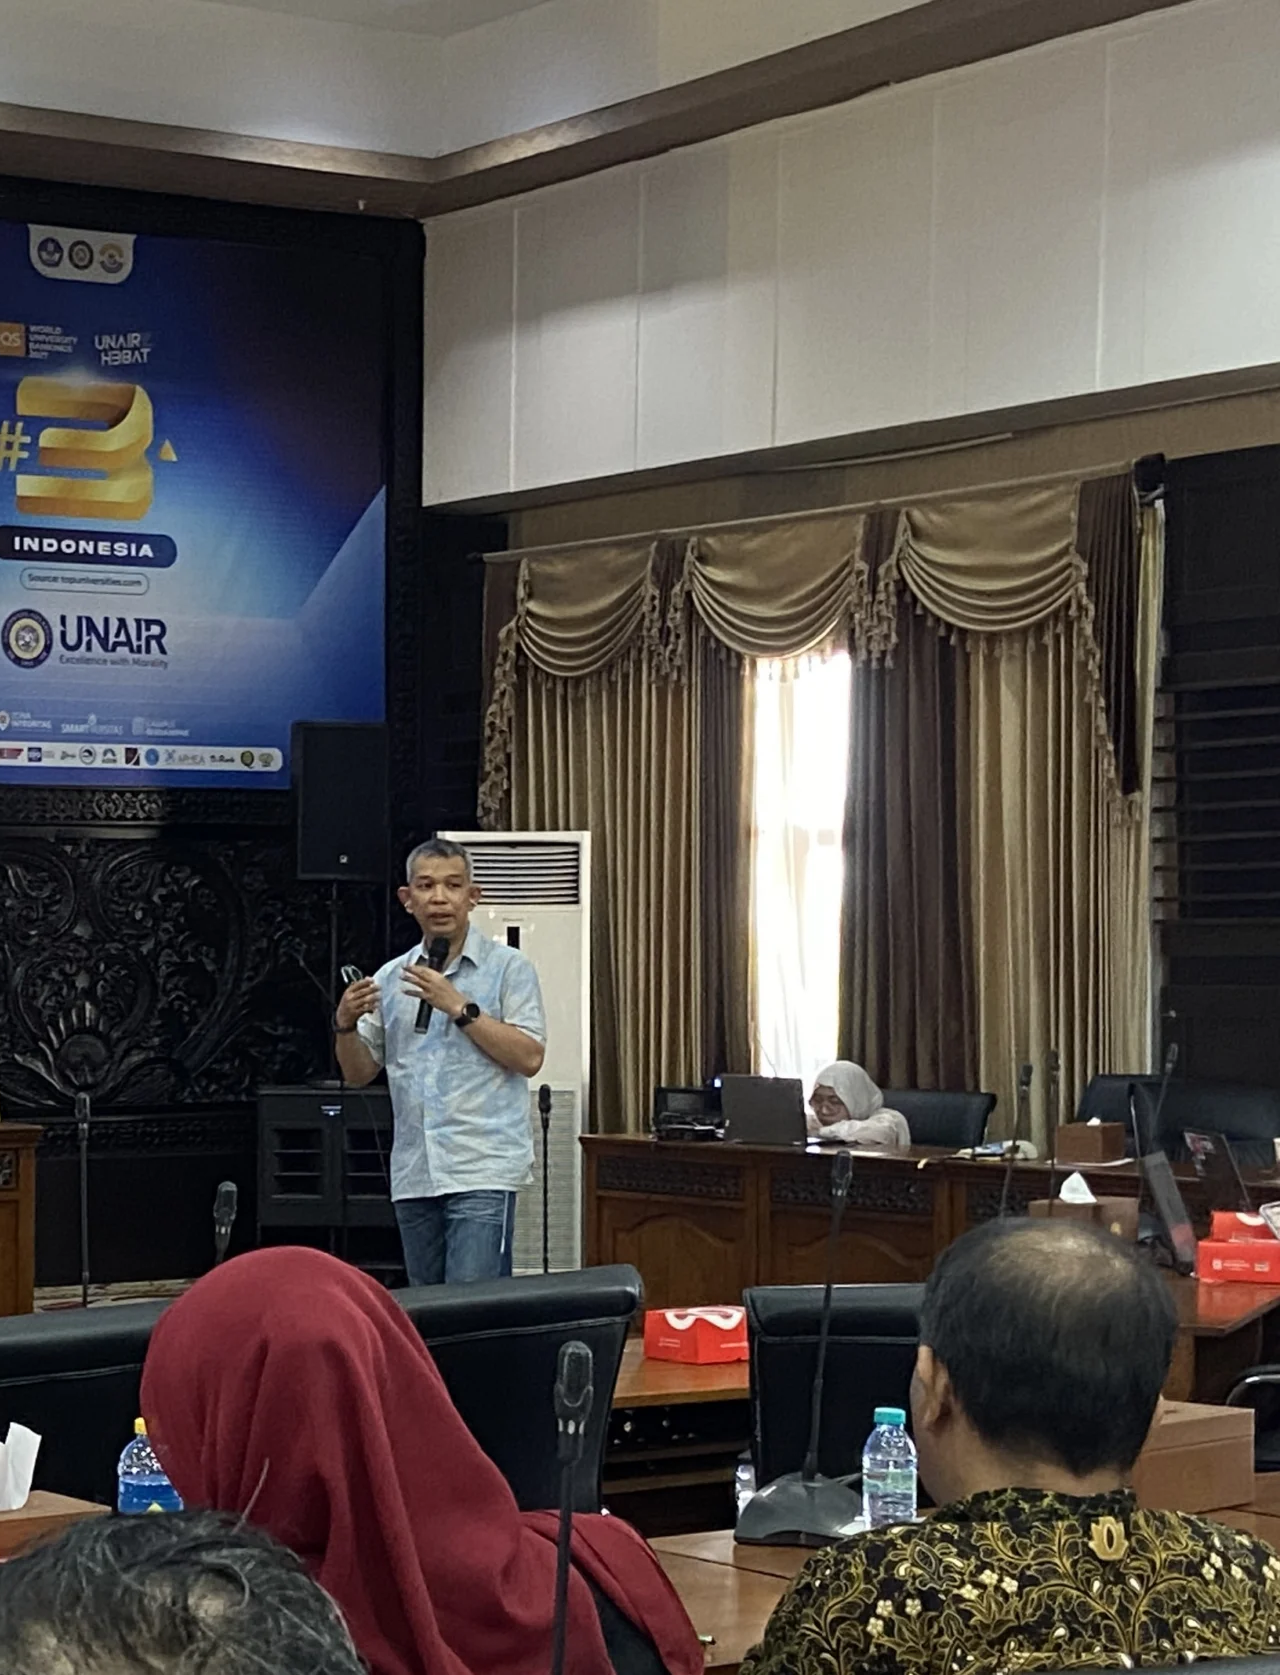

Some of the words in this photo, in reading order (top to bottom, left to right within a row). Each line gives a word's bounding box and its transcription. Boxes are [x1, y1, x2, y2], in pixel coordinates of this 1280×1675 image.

[0, 331, 20, 346] QS
[94, 333, 142, 350] UNAIR
[13, 536, 155, 559] INDONESIA
[59, 614, 169, 656] UNAIR
[59, 655, 108, 666] Excellence
[110, 656, 130, 666] with
